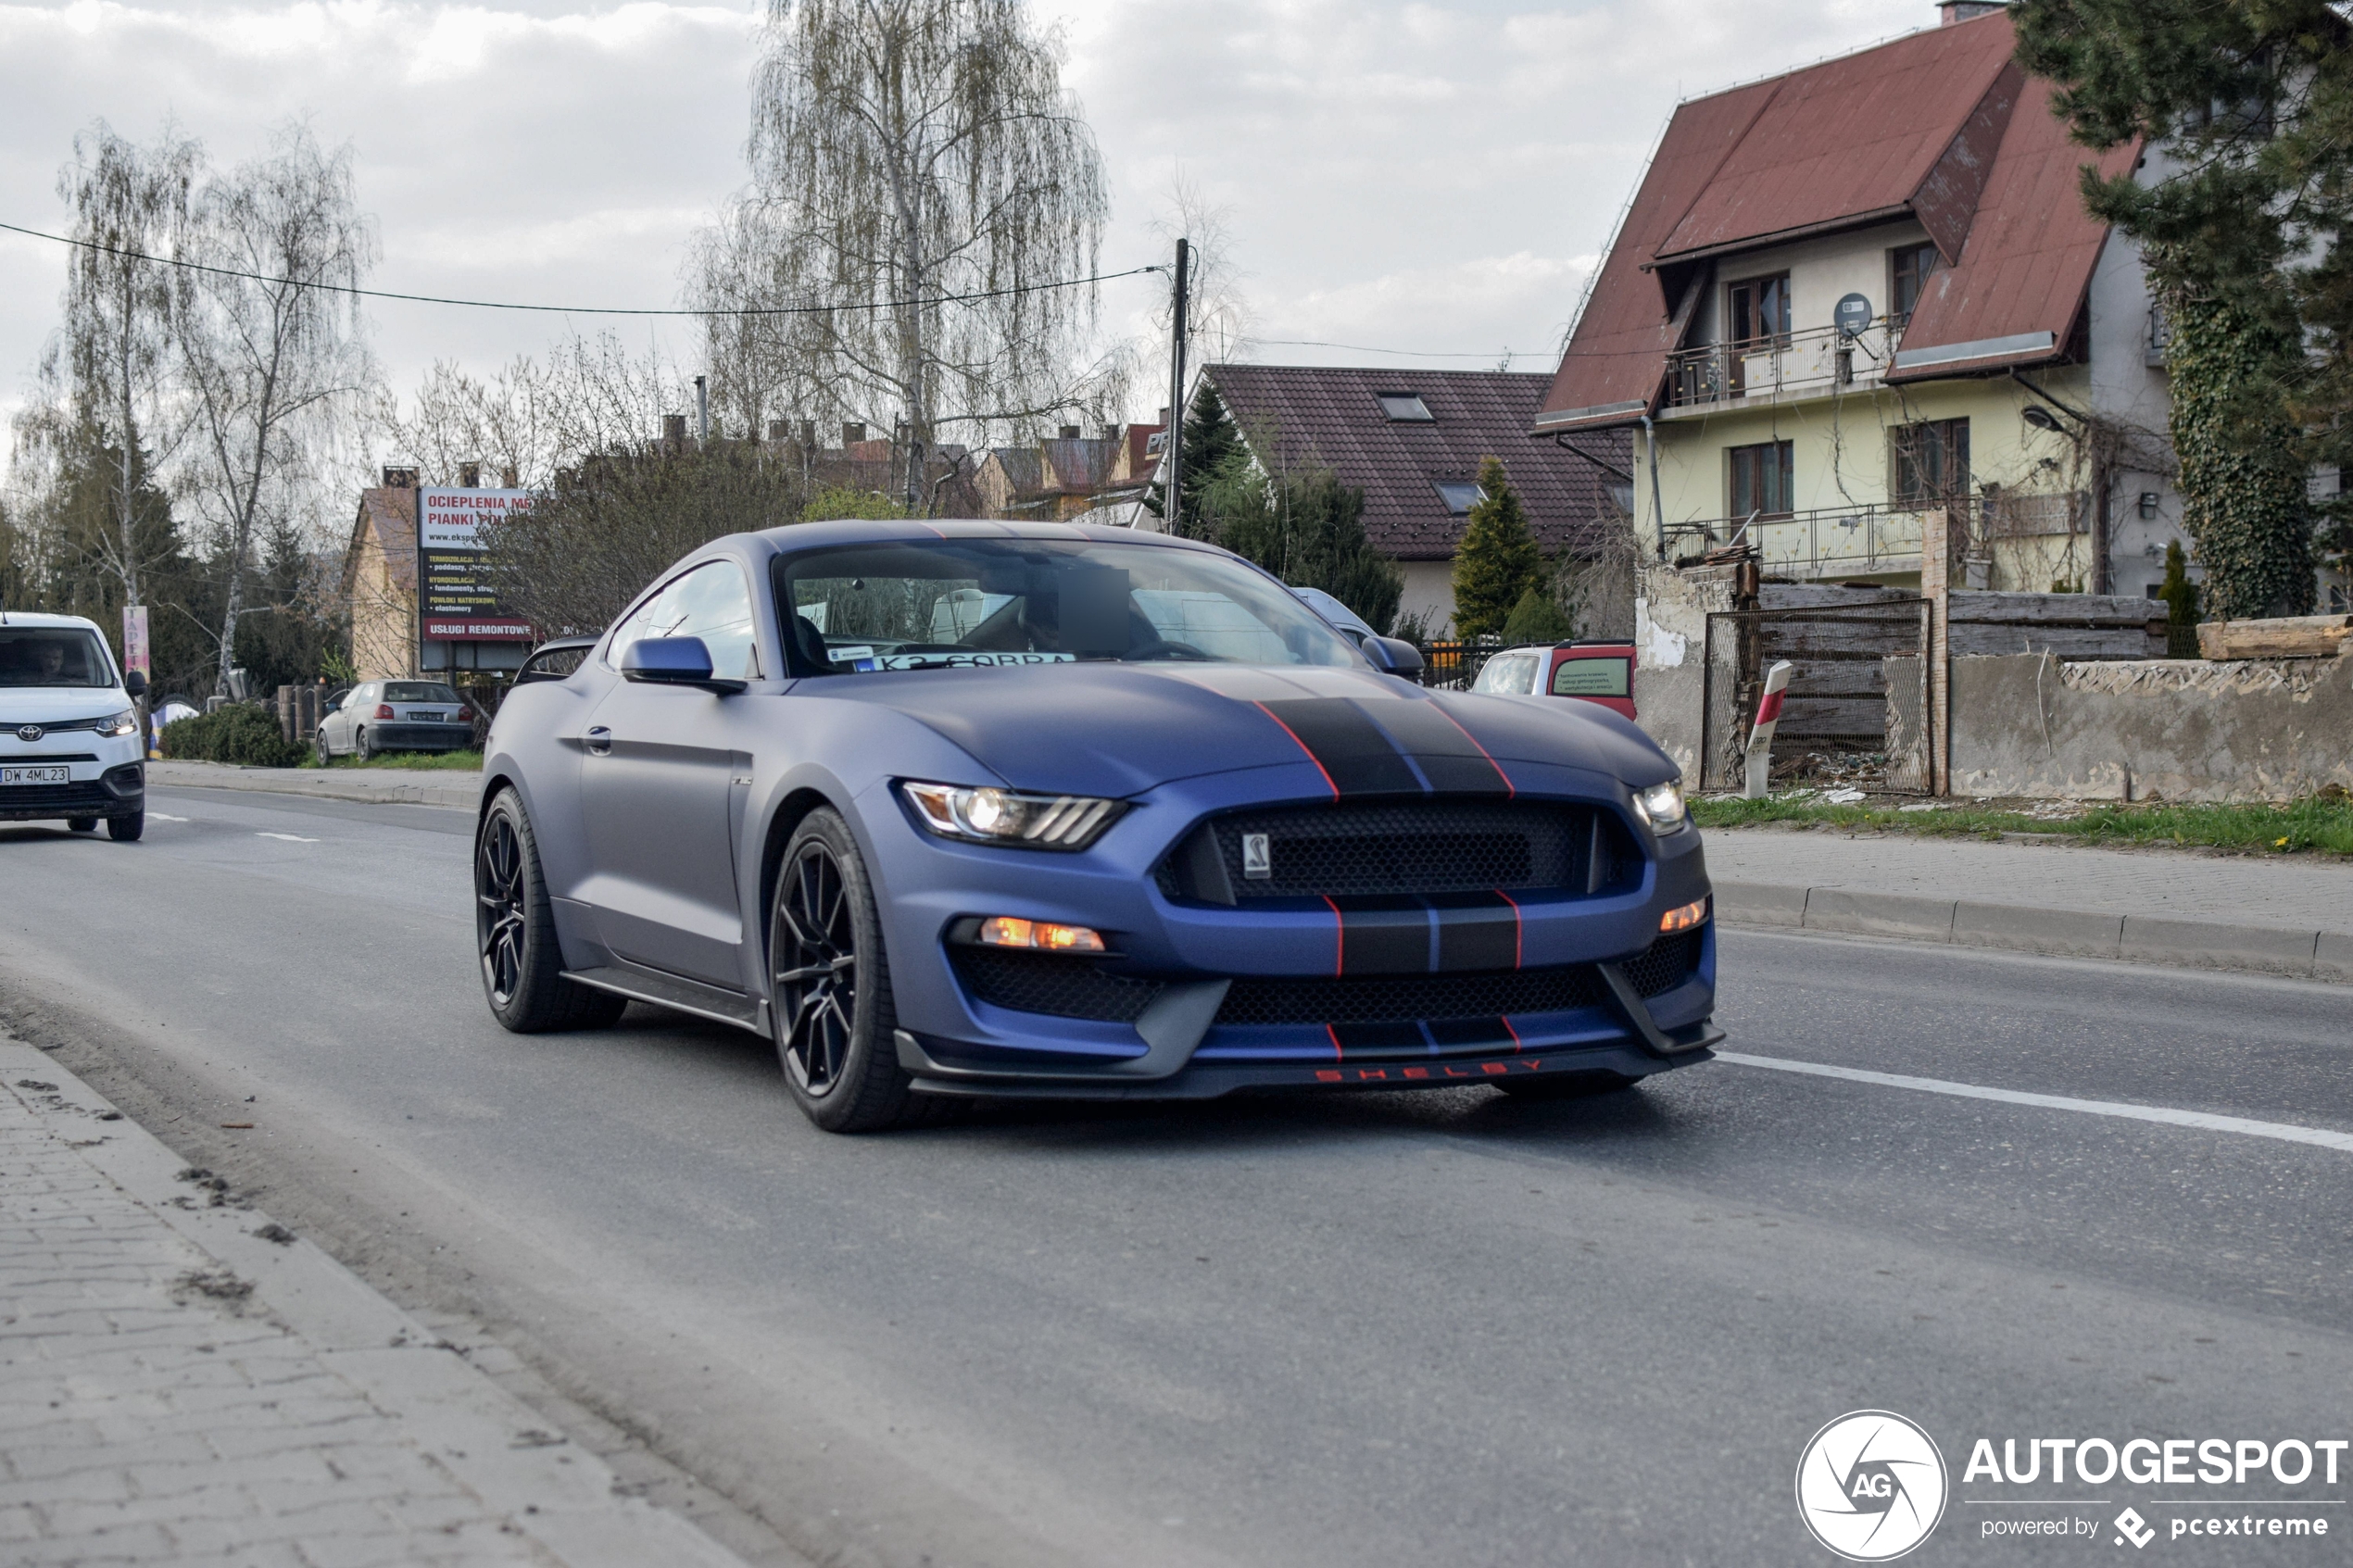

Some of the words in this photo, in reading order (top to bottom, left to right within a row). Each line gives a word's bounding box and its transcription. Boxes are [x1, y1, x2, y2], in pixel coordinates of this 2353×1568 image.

[428, 495, 506, 509] OCIEPLENIA
[428, 513, 473, 525] PIANKI
[434, 605, 472, 613] elastomery
[430, 625, 465, 634] USŁUGI
[469, 625, 531, 635] REMONTOWE
[127, 608, 139, 671] TAPET
[5, 770, 21, 782] DW
[26, 769, 66, 781] 4ML23
